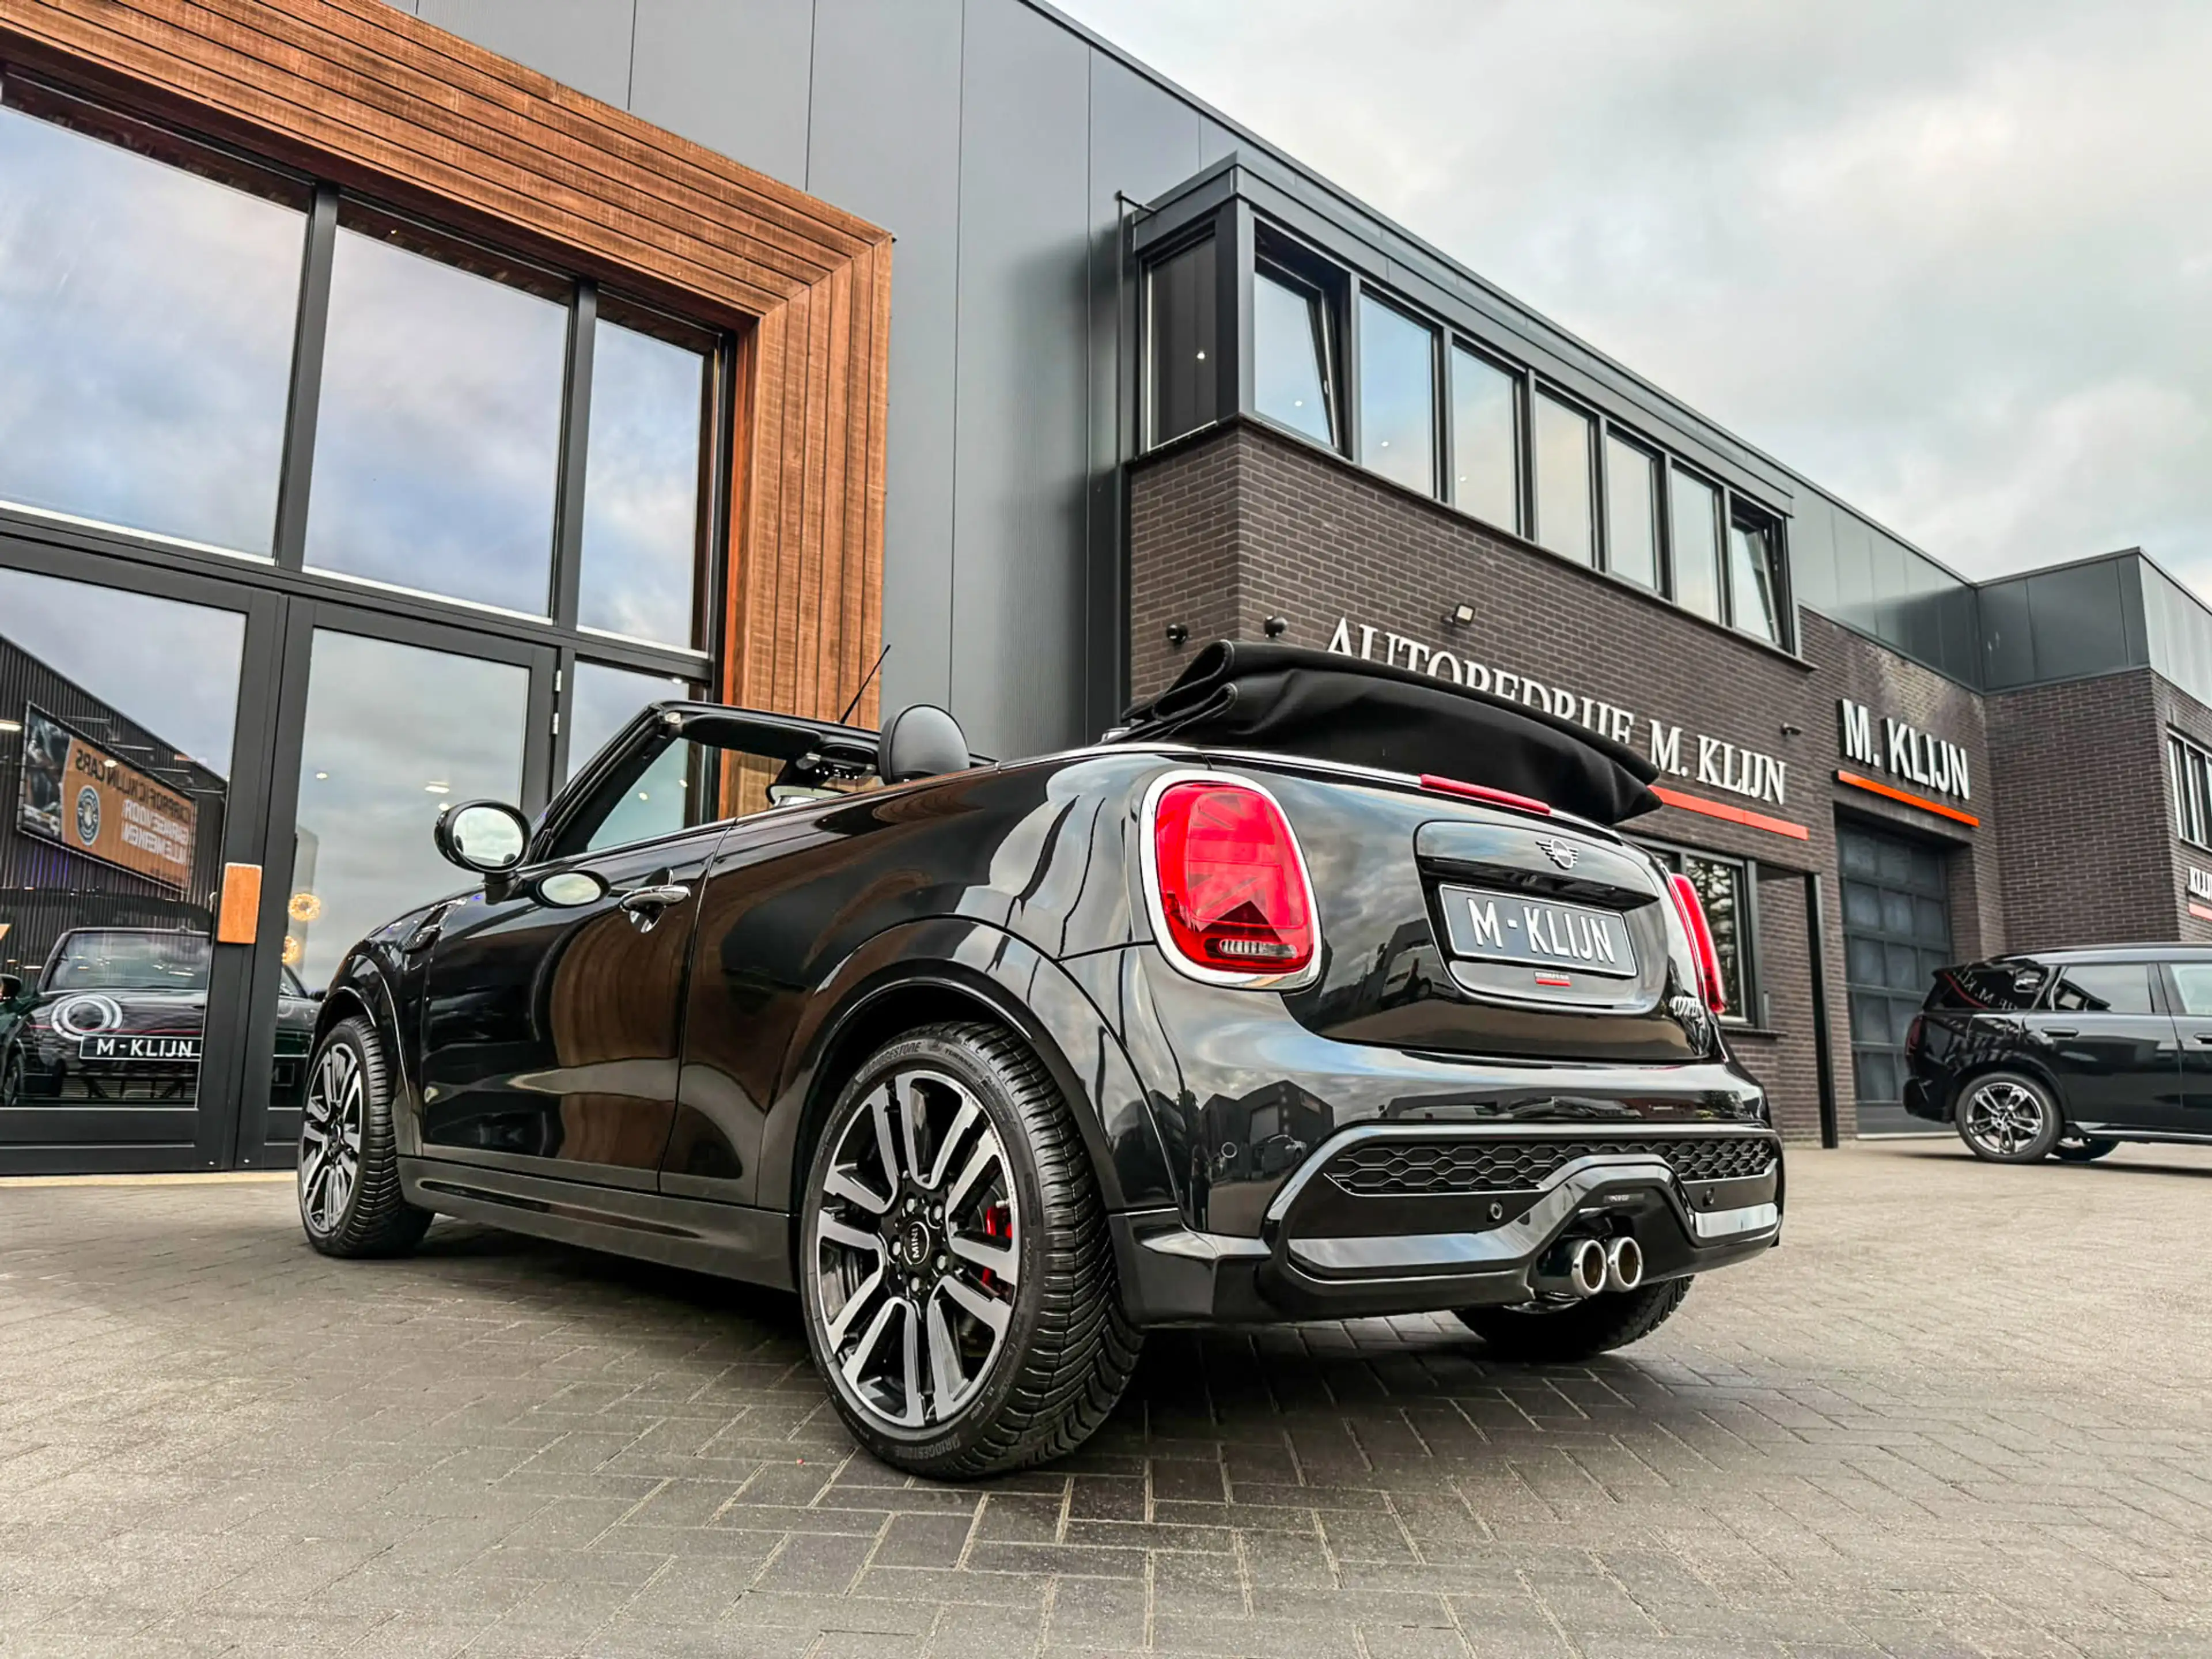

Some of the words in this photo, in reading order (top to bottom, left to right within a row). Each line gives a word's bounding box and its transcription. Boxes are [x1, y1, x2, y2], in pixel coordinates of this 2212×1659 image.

[1649, 719, 1689, 777] M.
[1696, 734, 1787, 805] KLIJN
[1843, 698, 1880, 767] M.
[1887, 717, 1970, 800] KLIJN
[911, 1228, 920, 1259] MINI
